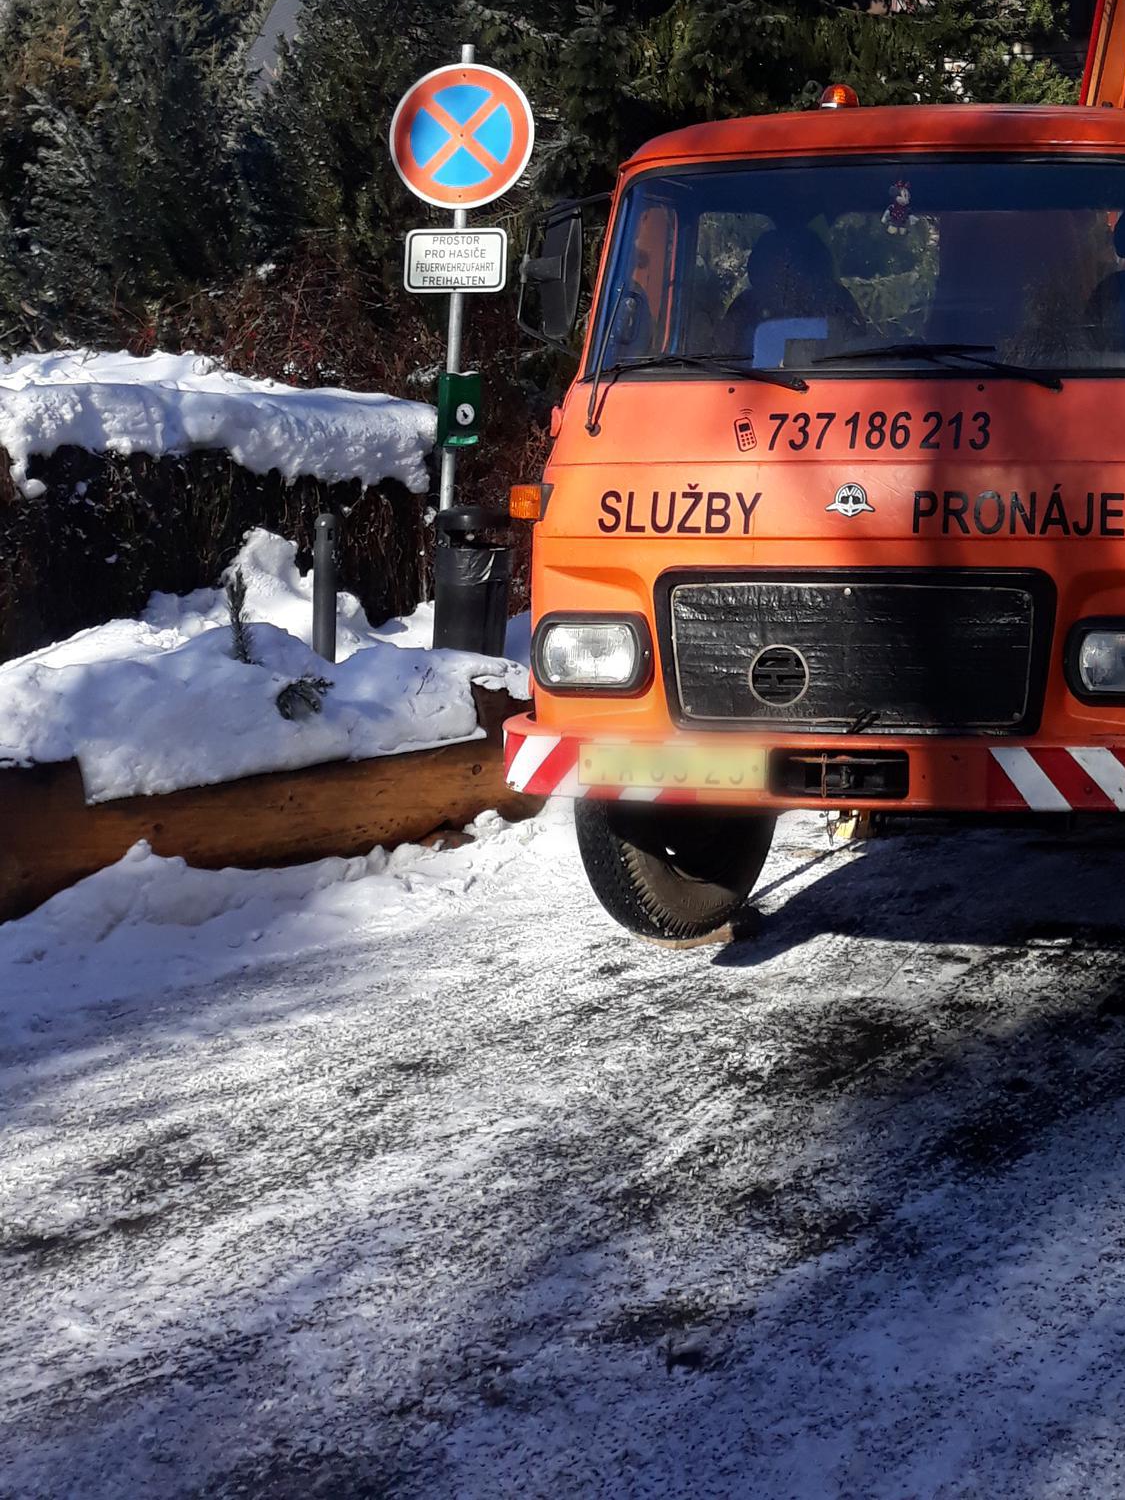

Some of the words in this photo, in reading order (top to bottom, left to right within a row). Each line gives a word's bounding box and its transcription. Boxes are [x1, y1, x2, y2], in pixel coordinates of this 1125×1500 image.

[432, 235, 480, 246] PROSTOR
[424, 249, 446, 259] PRO
[448, 247, 487, 259] HASIČE
[415, 262, 495, 273] FEUERWEHRZUFAHRT
[422, 276, 486, 286] FREIHALTEN
[768, 412, 837, 451] 737
[844, 411, 912, 450] 186
[919, 411, 991, 450] 213
[838, 486, 864, 503] AVIA
[598, 483, 763, 535] SLUŽBY
